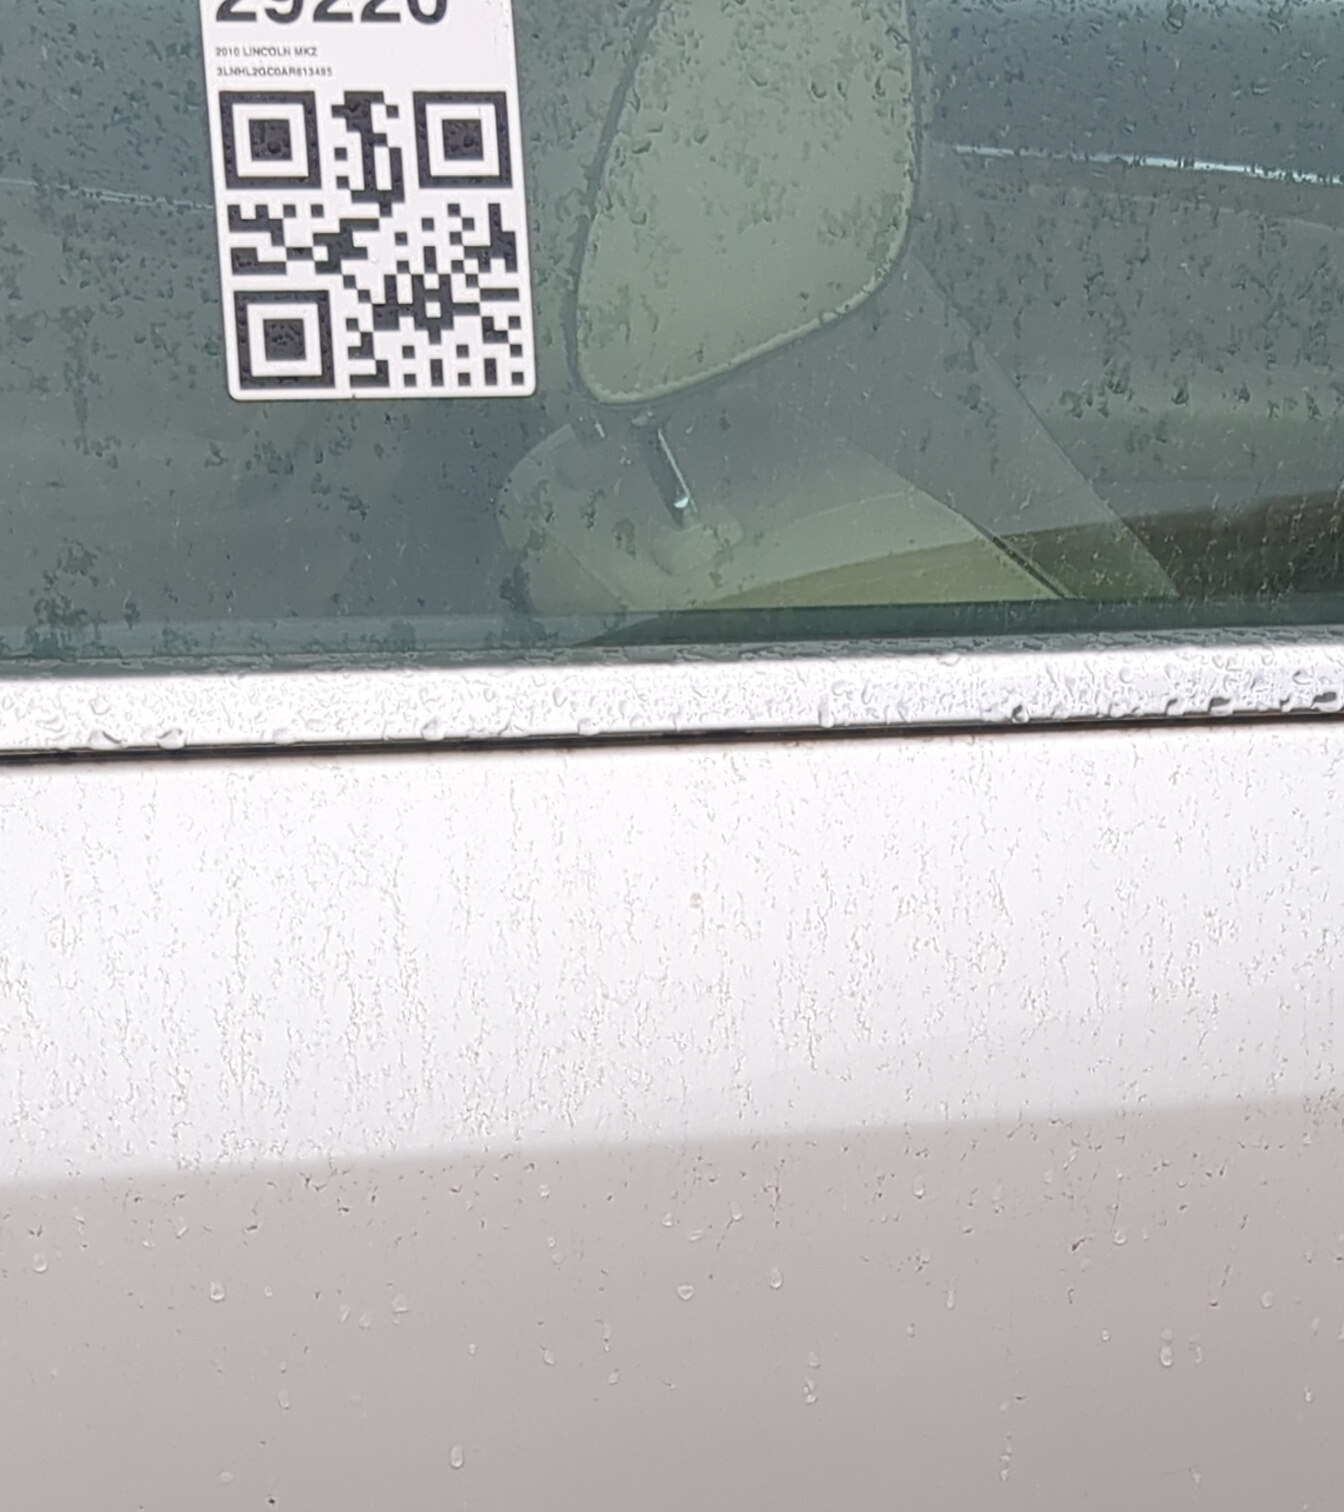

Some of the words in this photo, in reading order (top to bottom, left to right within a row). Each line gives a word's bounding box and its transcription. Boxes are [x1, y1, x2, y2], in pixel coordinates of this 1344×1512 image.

[216, 46, 240, 57] 2010
[243, 46, 291, 57] LINCOLN
[295, 46, 318, 57] MKZ
